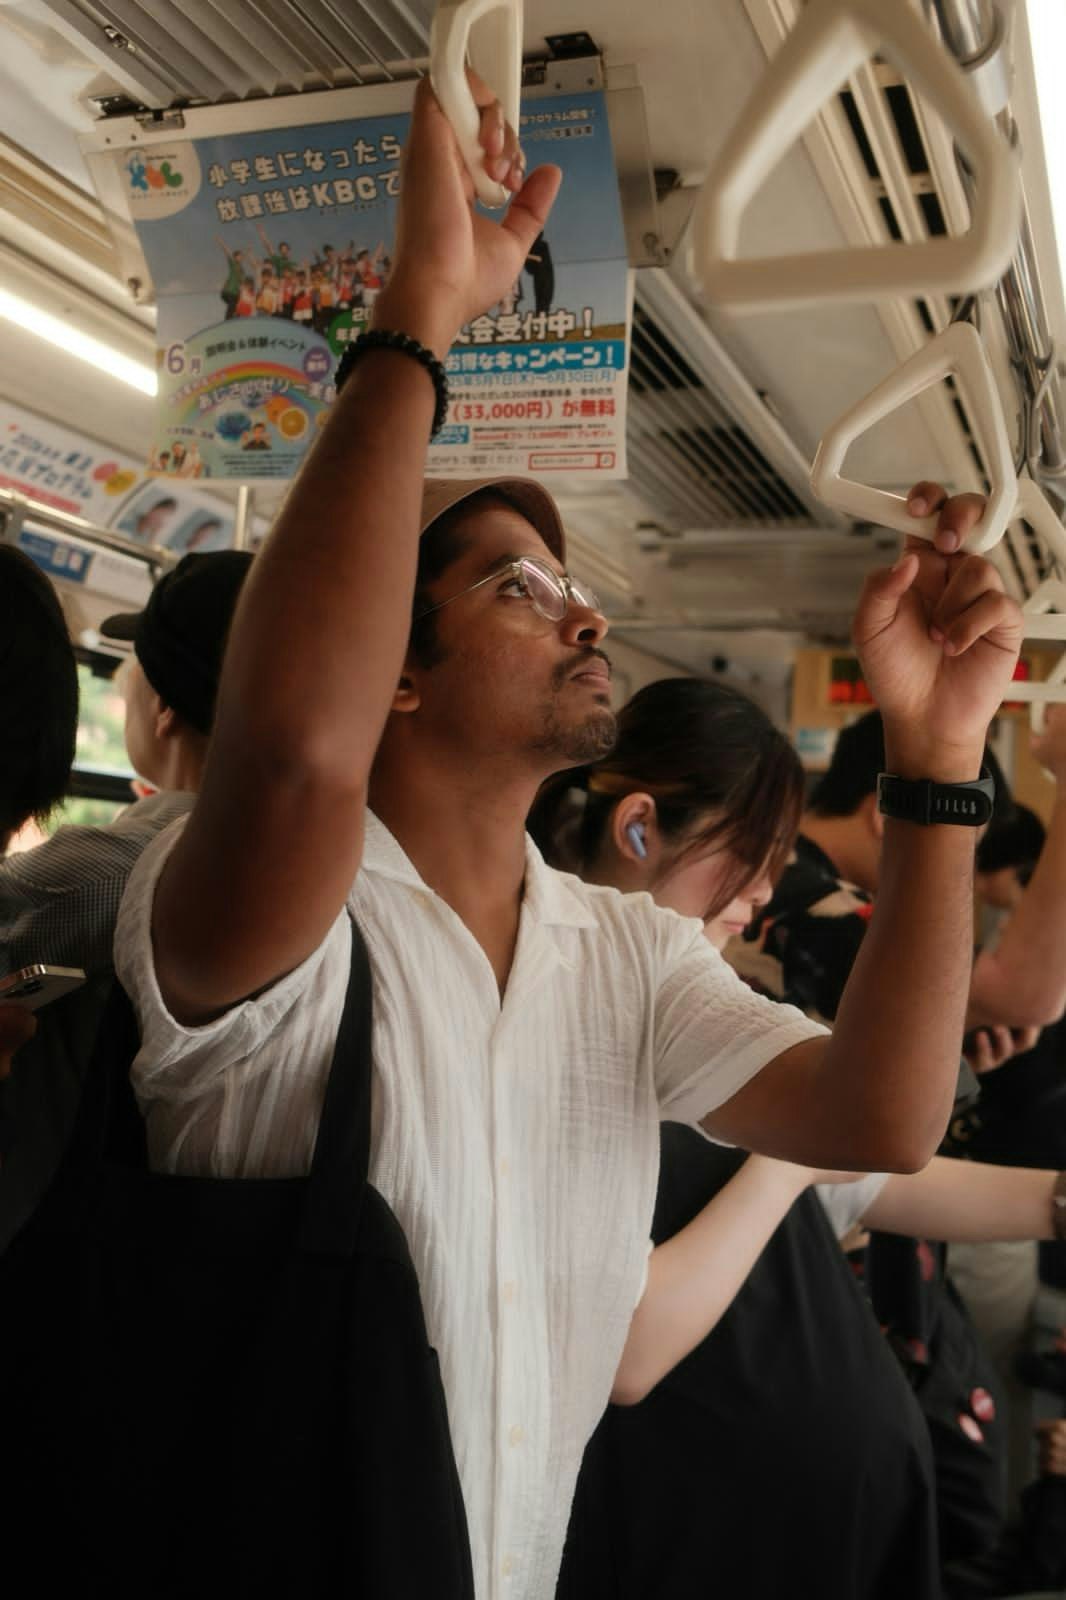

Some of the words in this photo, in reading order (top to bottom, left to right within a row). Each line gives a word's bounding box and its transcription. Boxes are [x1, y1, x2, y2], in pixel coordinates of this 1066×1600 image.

[208, 134, 401, 189] 小学生になったら
[445, 346, 614, 371] お得なキャンペーン！
